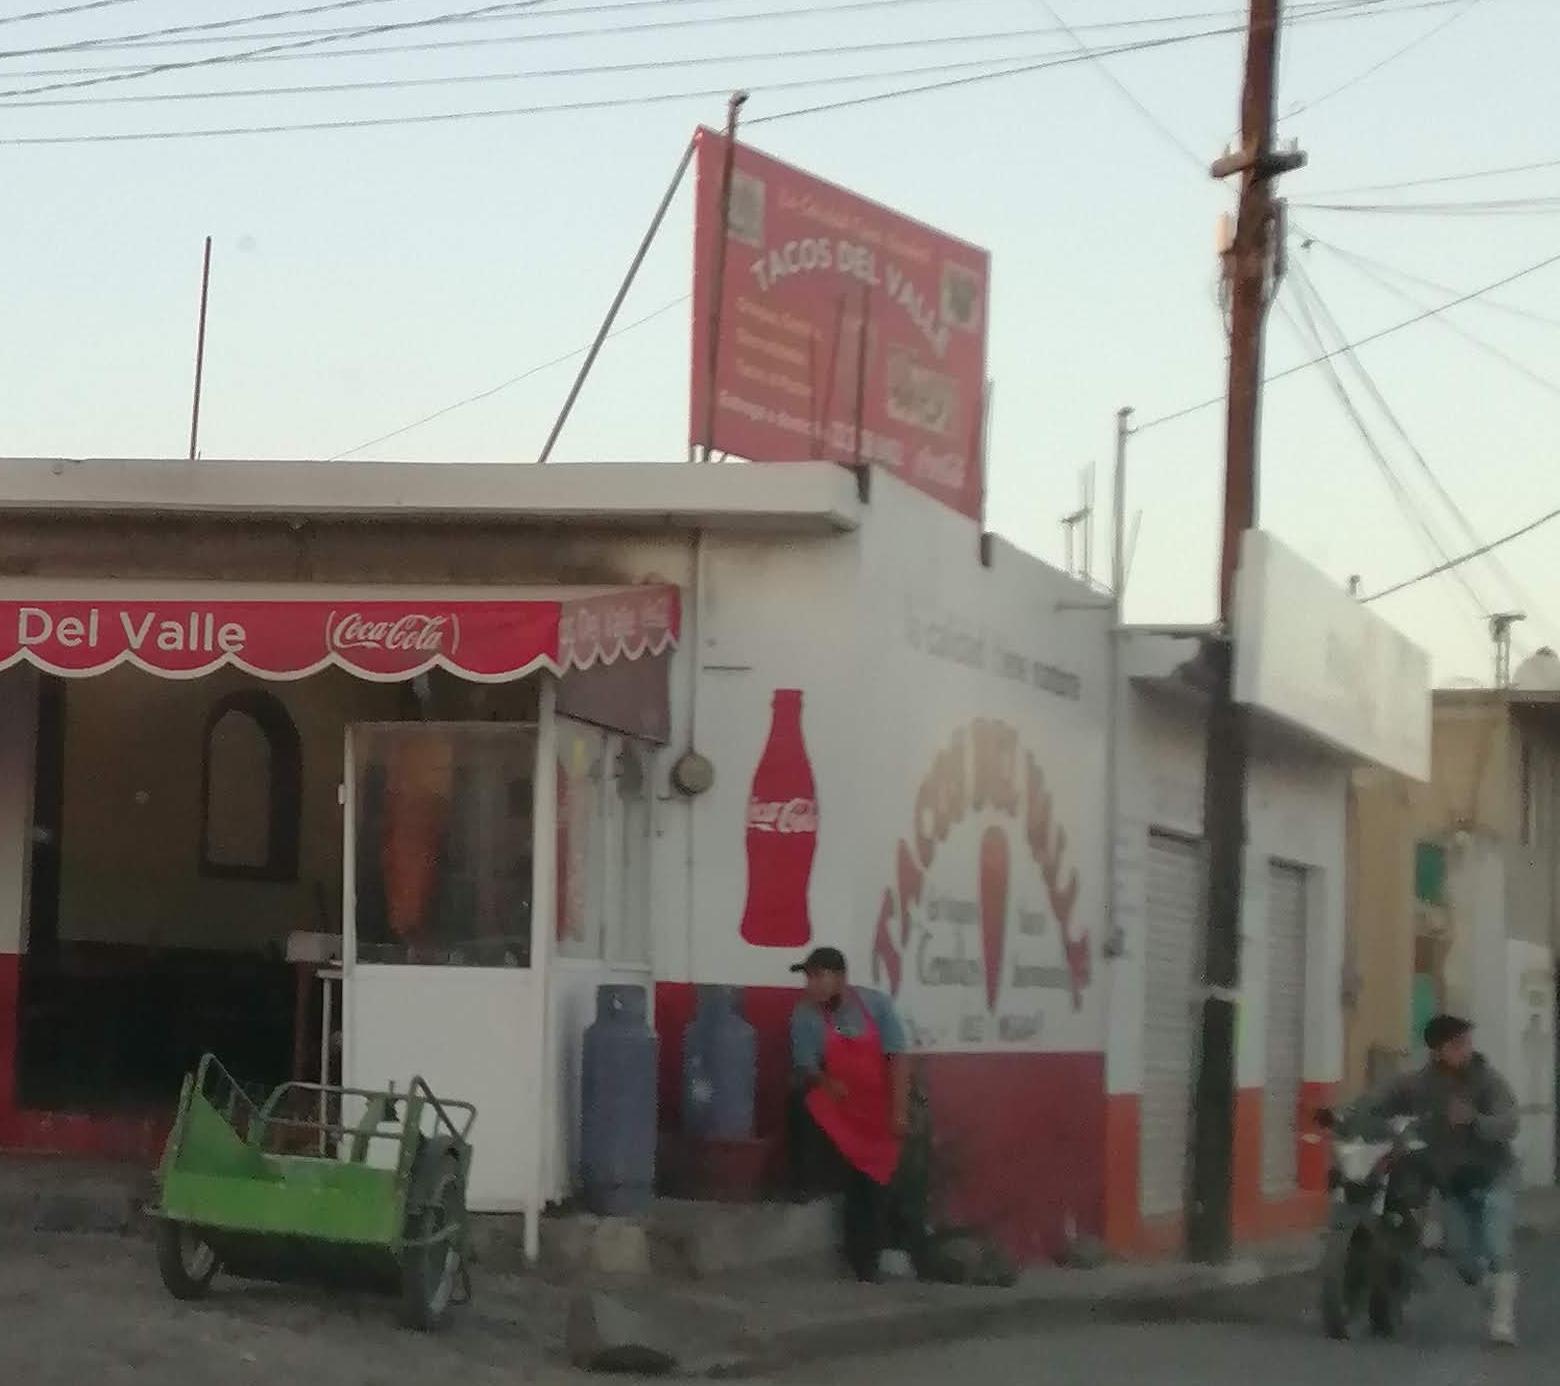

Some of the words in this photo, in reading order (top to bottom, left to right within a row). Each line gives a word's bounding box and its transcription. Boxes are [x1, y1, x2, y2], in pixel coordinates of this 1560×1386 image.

[18, 607, 99, 648] Del
[120, 610, 247, 653] Valle
[333, 613, 447, 651] Coca-Cola
